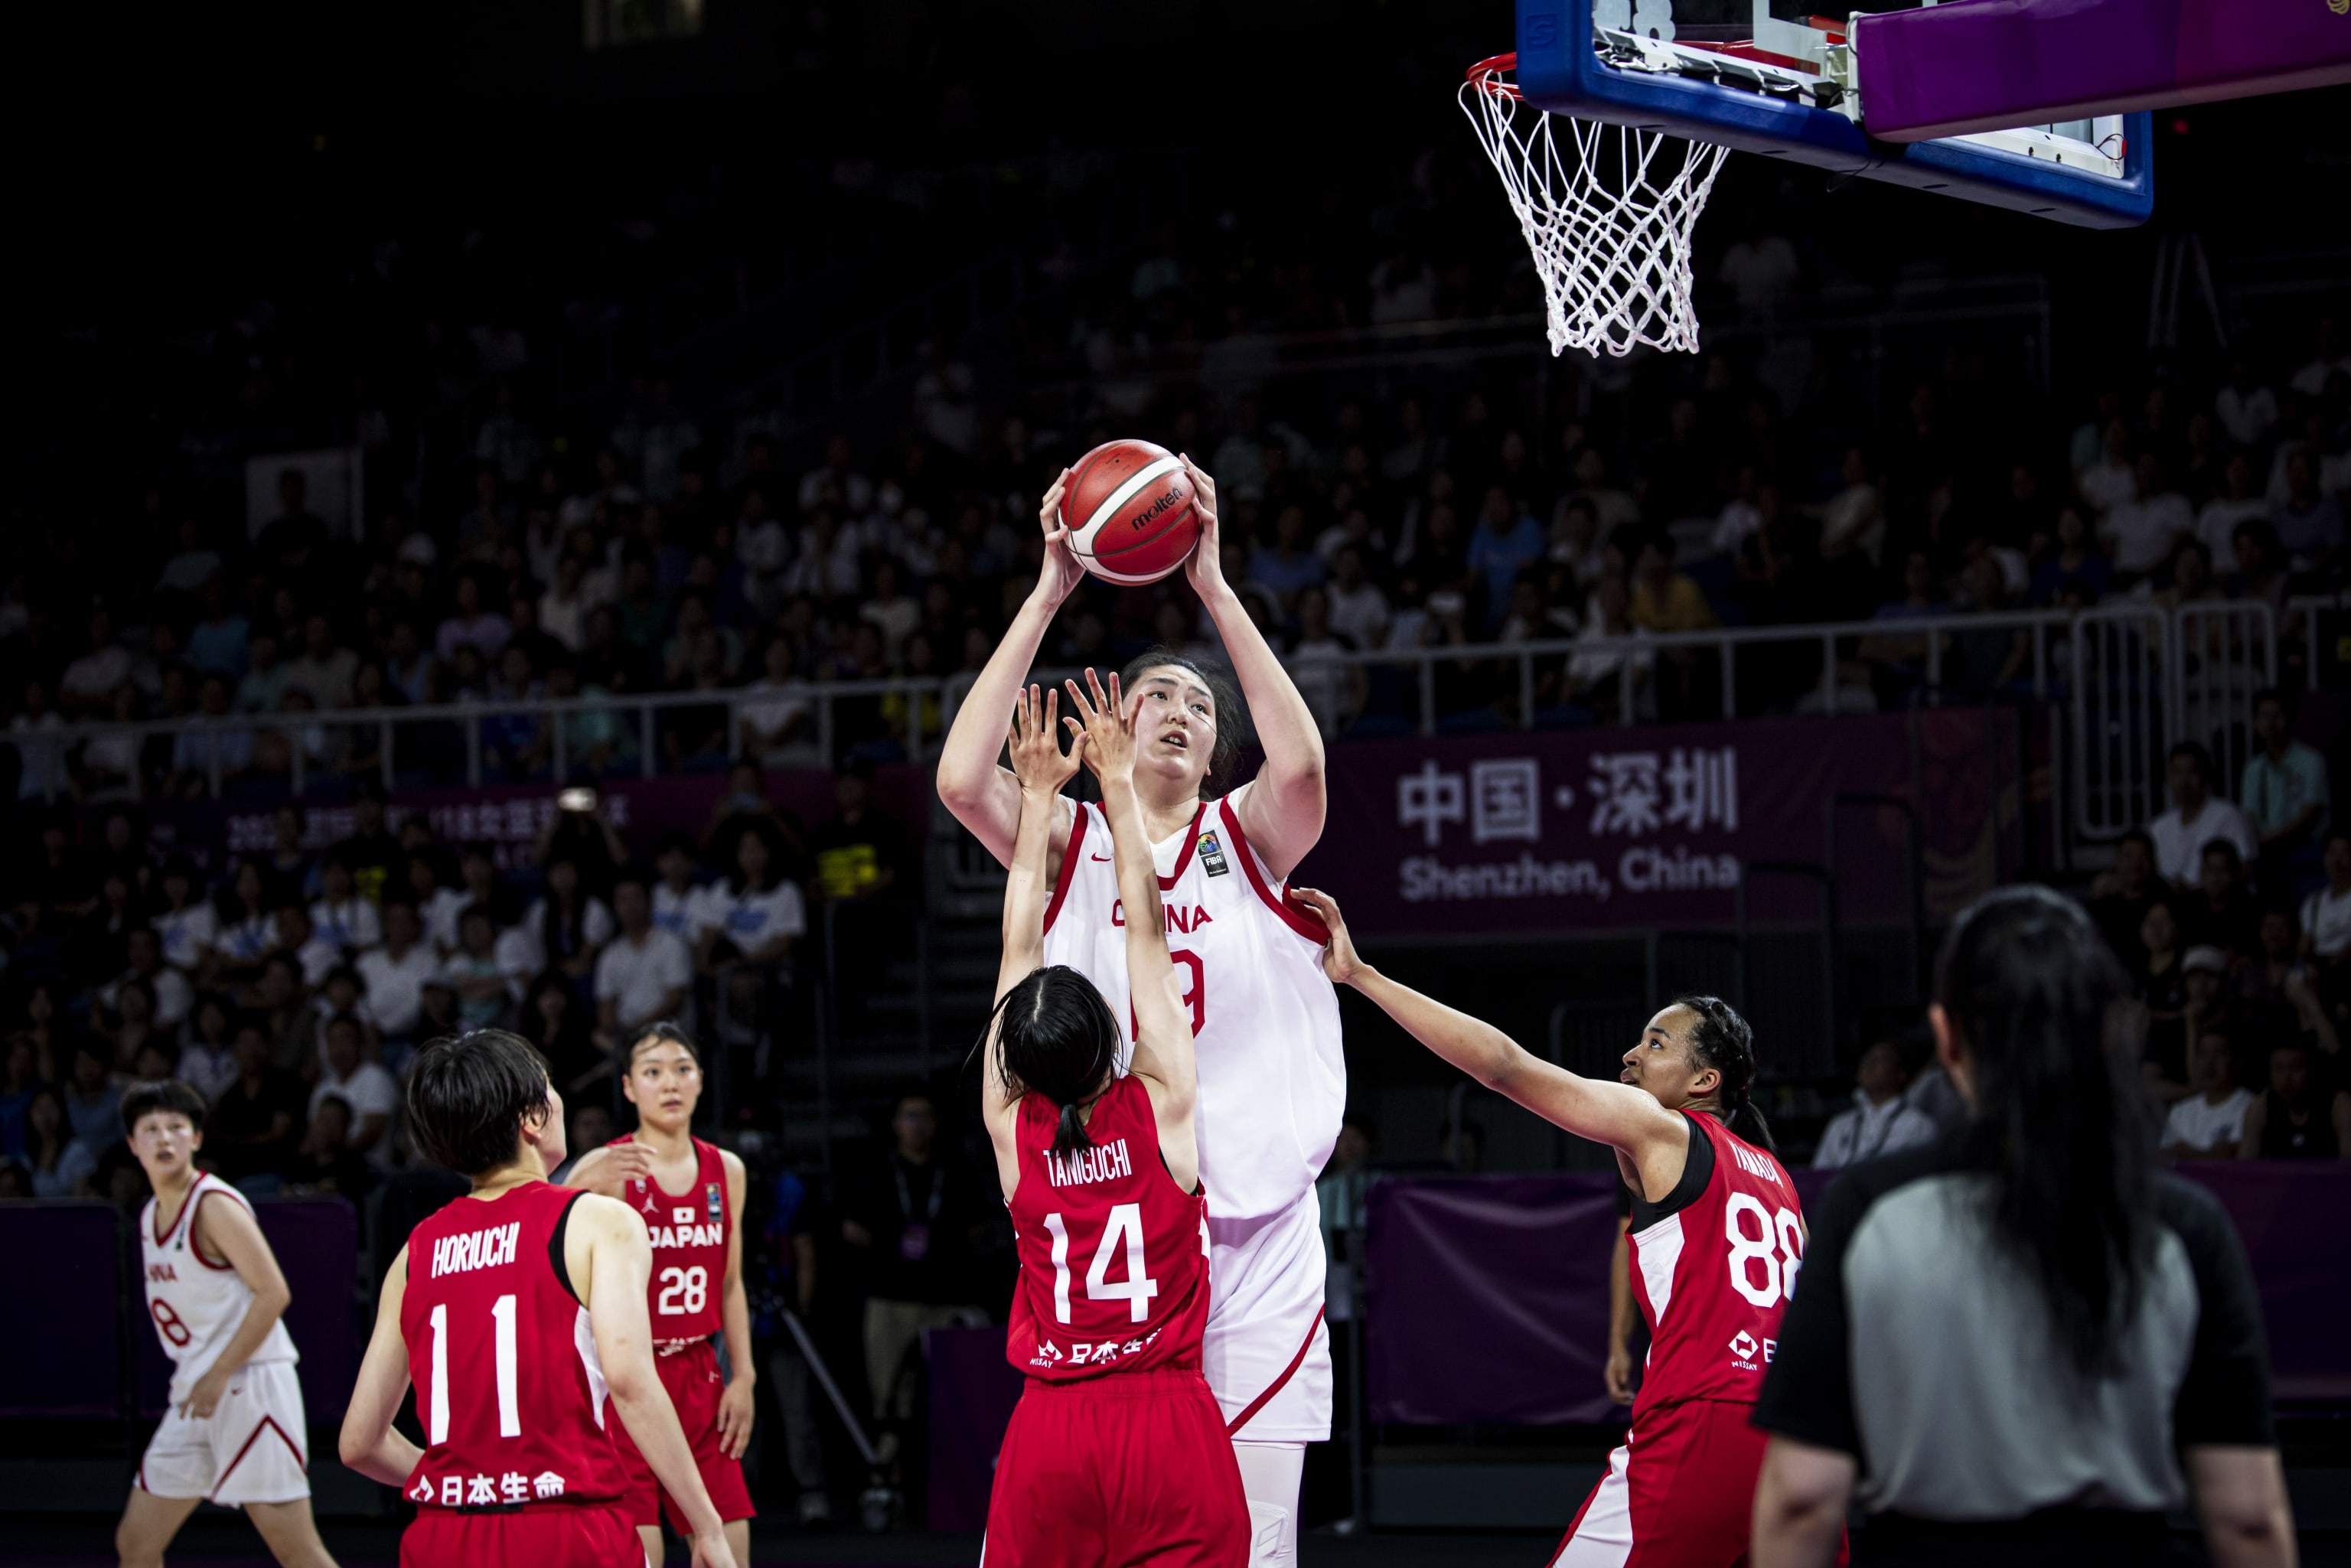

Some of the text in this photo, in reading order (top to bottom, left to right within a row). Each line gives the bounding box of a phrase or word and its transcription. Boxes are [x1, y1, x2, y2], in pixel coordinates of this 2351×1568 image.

[1131, 487, 1183, 531] molten
[1397, 745, 1739, 846] 中国·深圳
[1205, 855, 1222, 866] FIBA
[1399, 845, 1740, 901] Shenzhen, China
[1111, 898, 1213, 934] CINA
[1042, 1139, 1132, 1187] TANIGUCHI
[431, 1221, 520, 1279] HORIUCHI
[649, 1223, 722, 1248] JAPAN
[1043, 1202, 1158, 1325] 14
[658, 1265, 708, 1315] 28
[429, 1293, 521, 1446] 11
[1731, 1361, 1758, 1371] NISSAY
[442, 1471, 566, 1506] 日本生命
